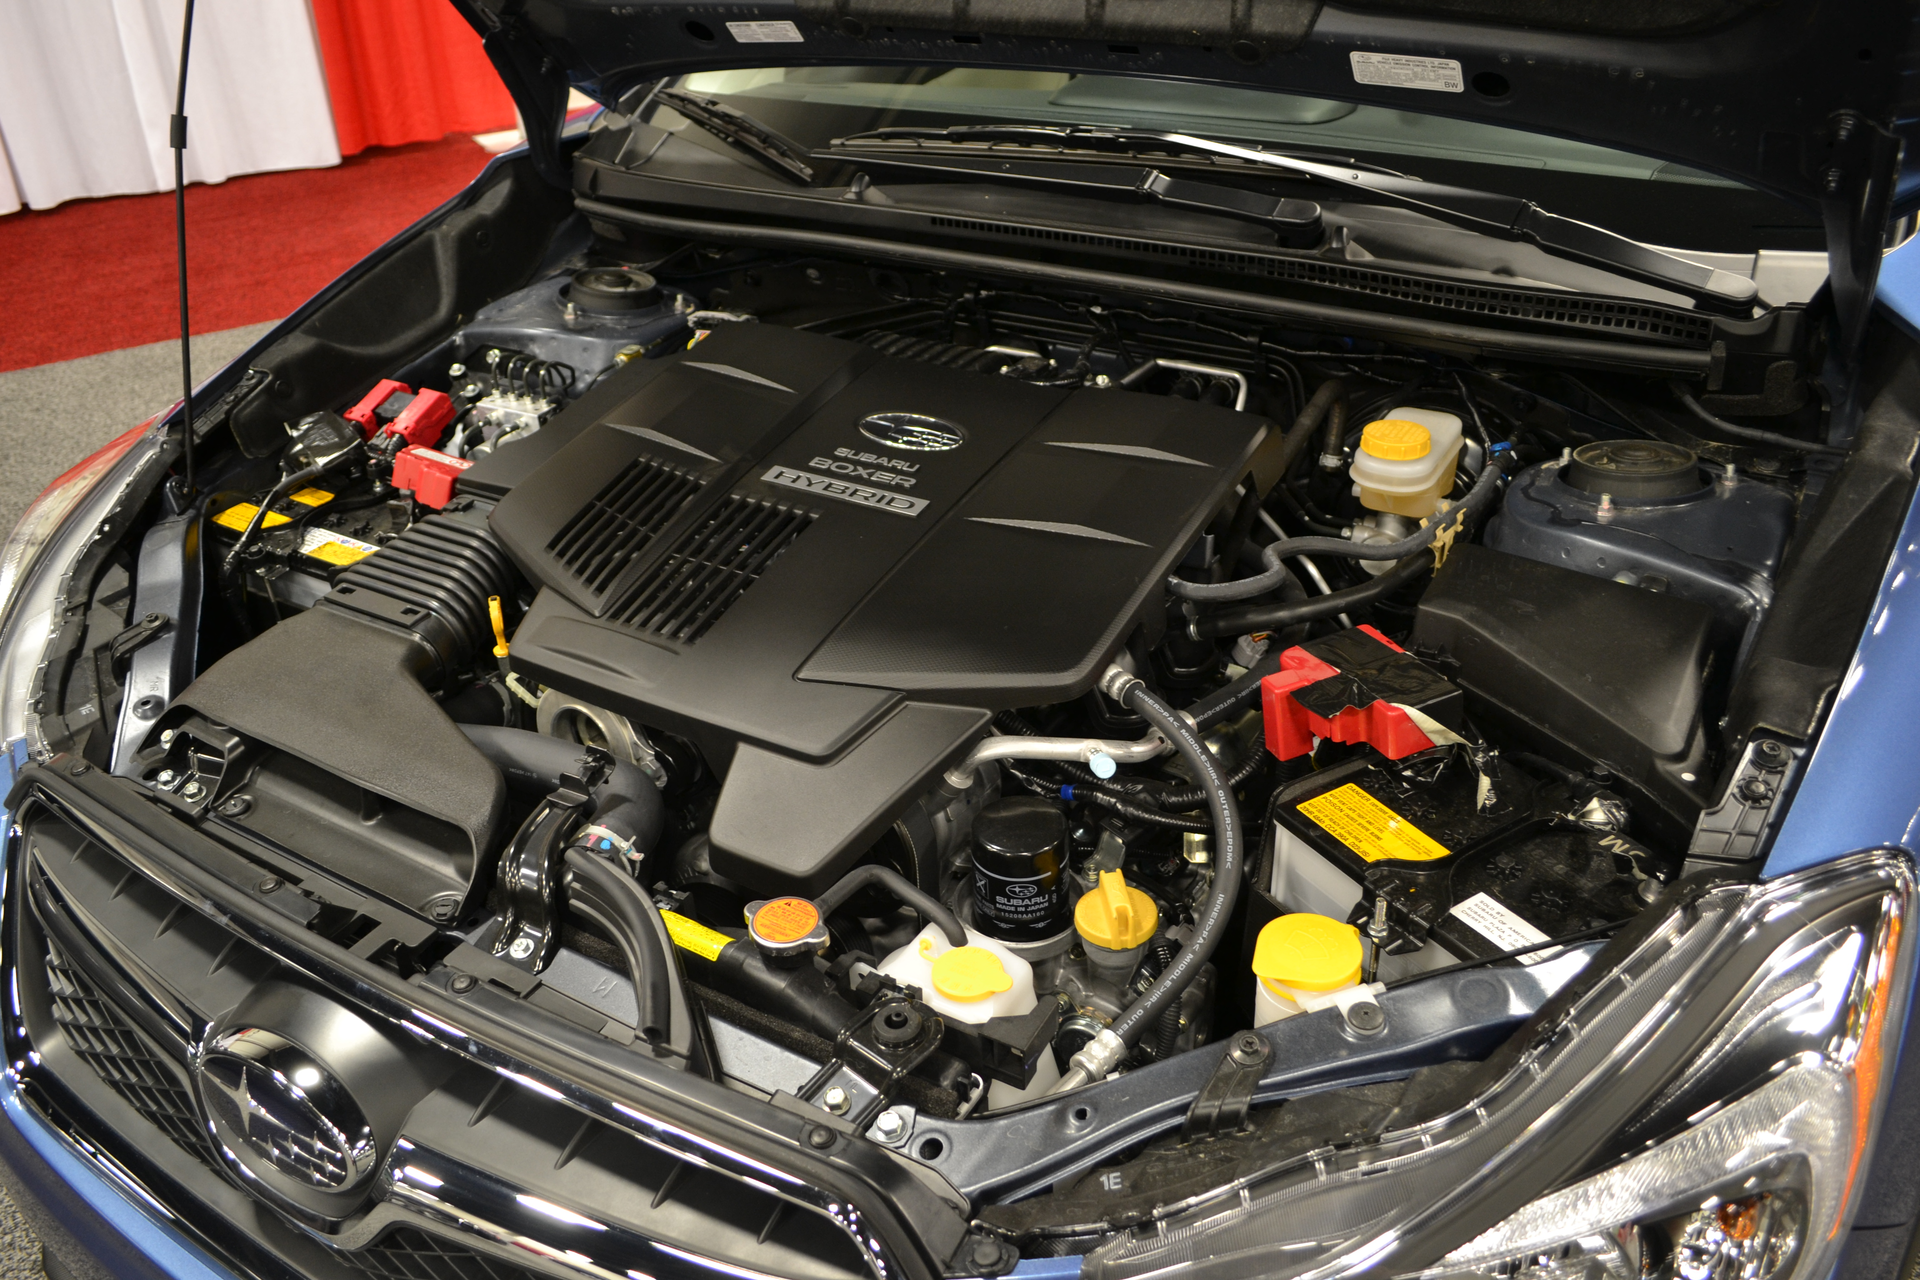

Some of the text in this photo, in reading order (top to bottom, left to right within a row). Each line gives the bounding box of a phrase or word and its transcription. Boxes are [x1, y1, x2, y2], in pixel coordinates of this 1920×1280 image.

[834, 447, 920, 472] SUBARU
[808, 456, 917, 488] BOXER
[774, 470, 916, 510] HYBRID
[1346, 785, 1371, 802] DANGER
[1321, 796, 1345, 812] POISON
[1324, 824, 1338, 832] CCA
[996, 894, 1048, 906] SUBARU
[996, 903, 1016, 911] MADE
[1026, 902, 1048, 910] JAPAN
[1479, 900, 1495, 911] SOLD
[1461, 909, 1481, 924] CHERRY
[1474, 903, 1498, 919] SUBARU
[1467, 906, 1488, 921] SUBARU
[1488, 922, 1506, 933] PLAZA
[1100, 1172, 1122, 1190] 1E
